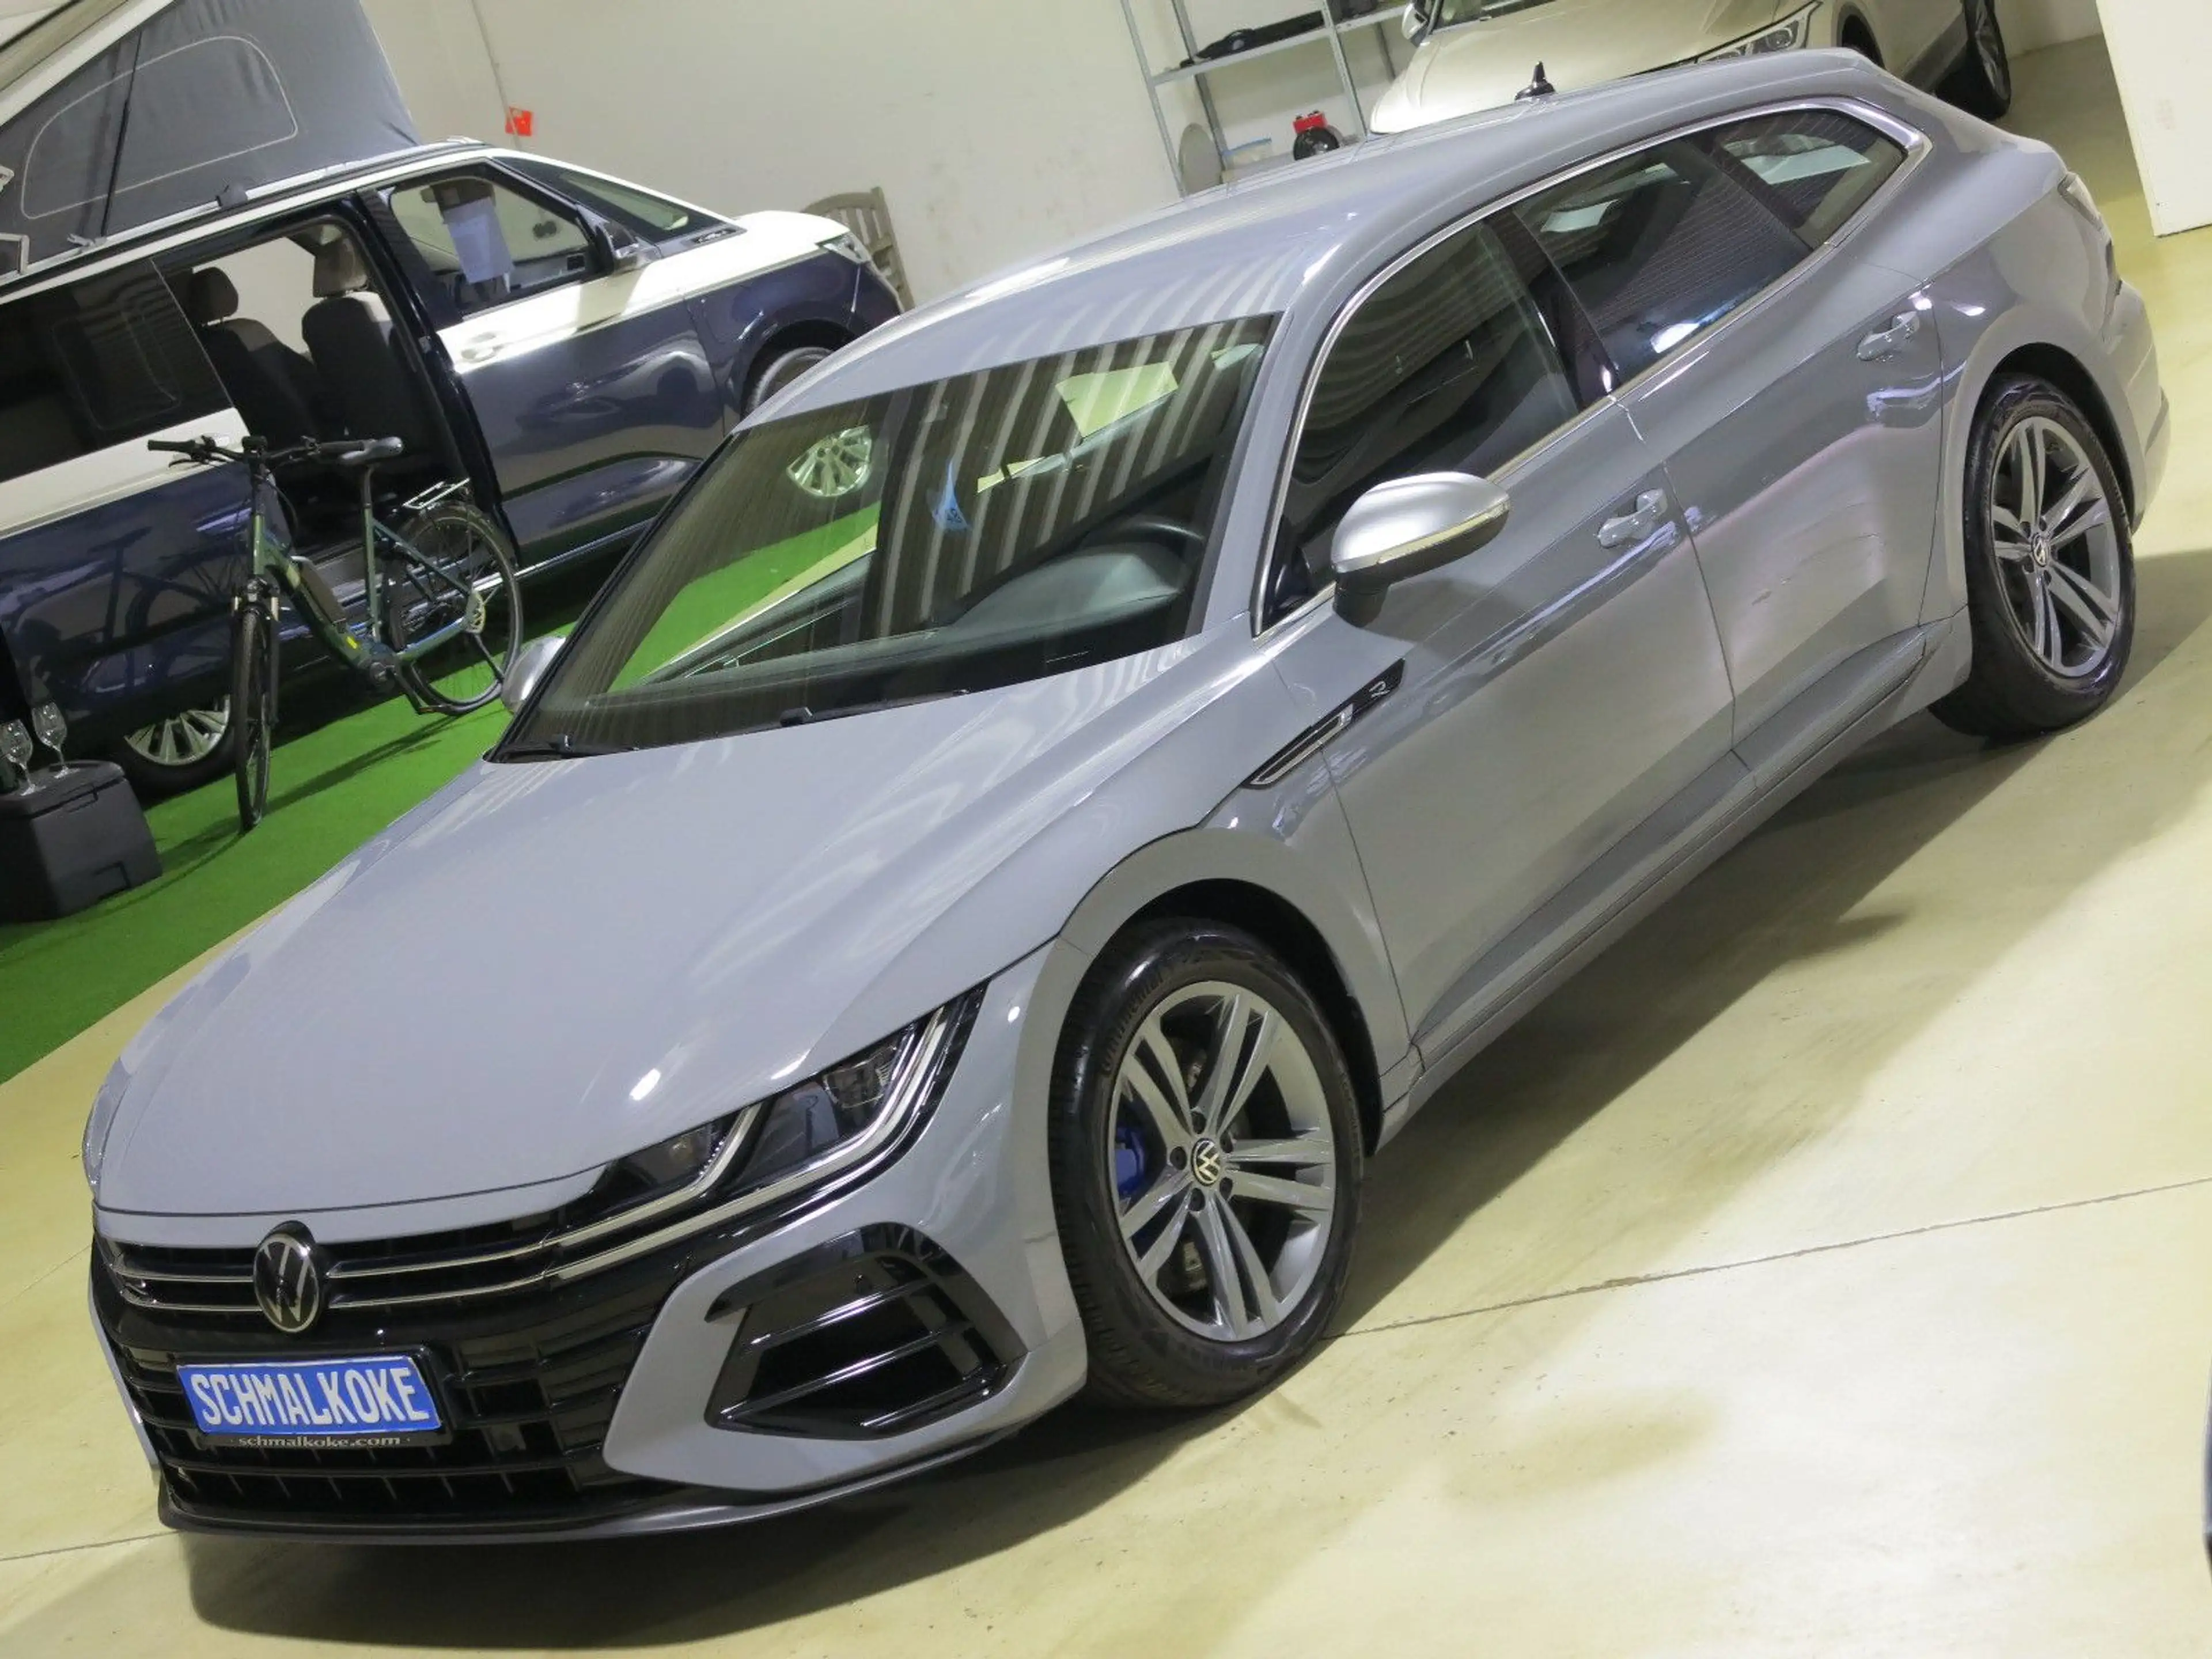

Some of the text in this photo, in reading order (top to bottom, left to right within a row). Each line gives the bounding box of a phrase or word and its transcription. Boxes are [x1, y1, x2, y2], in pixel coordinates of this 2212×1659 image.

[1369, 681, 1390, 698] R
[191, 1367, 430, 1426] SCHMALKOKE
[238, 1435, 401, 1448] schmalkoke.com
